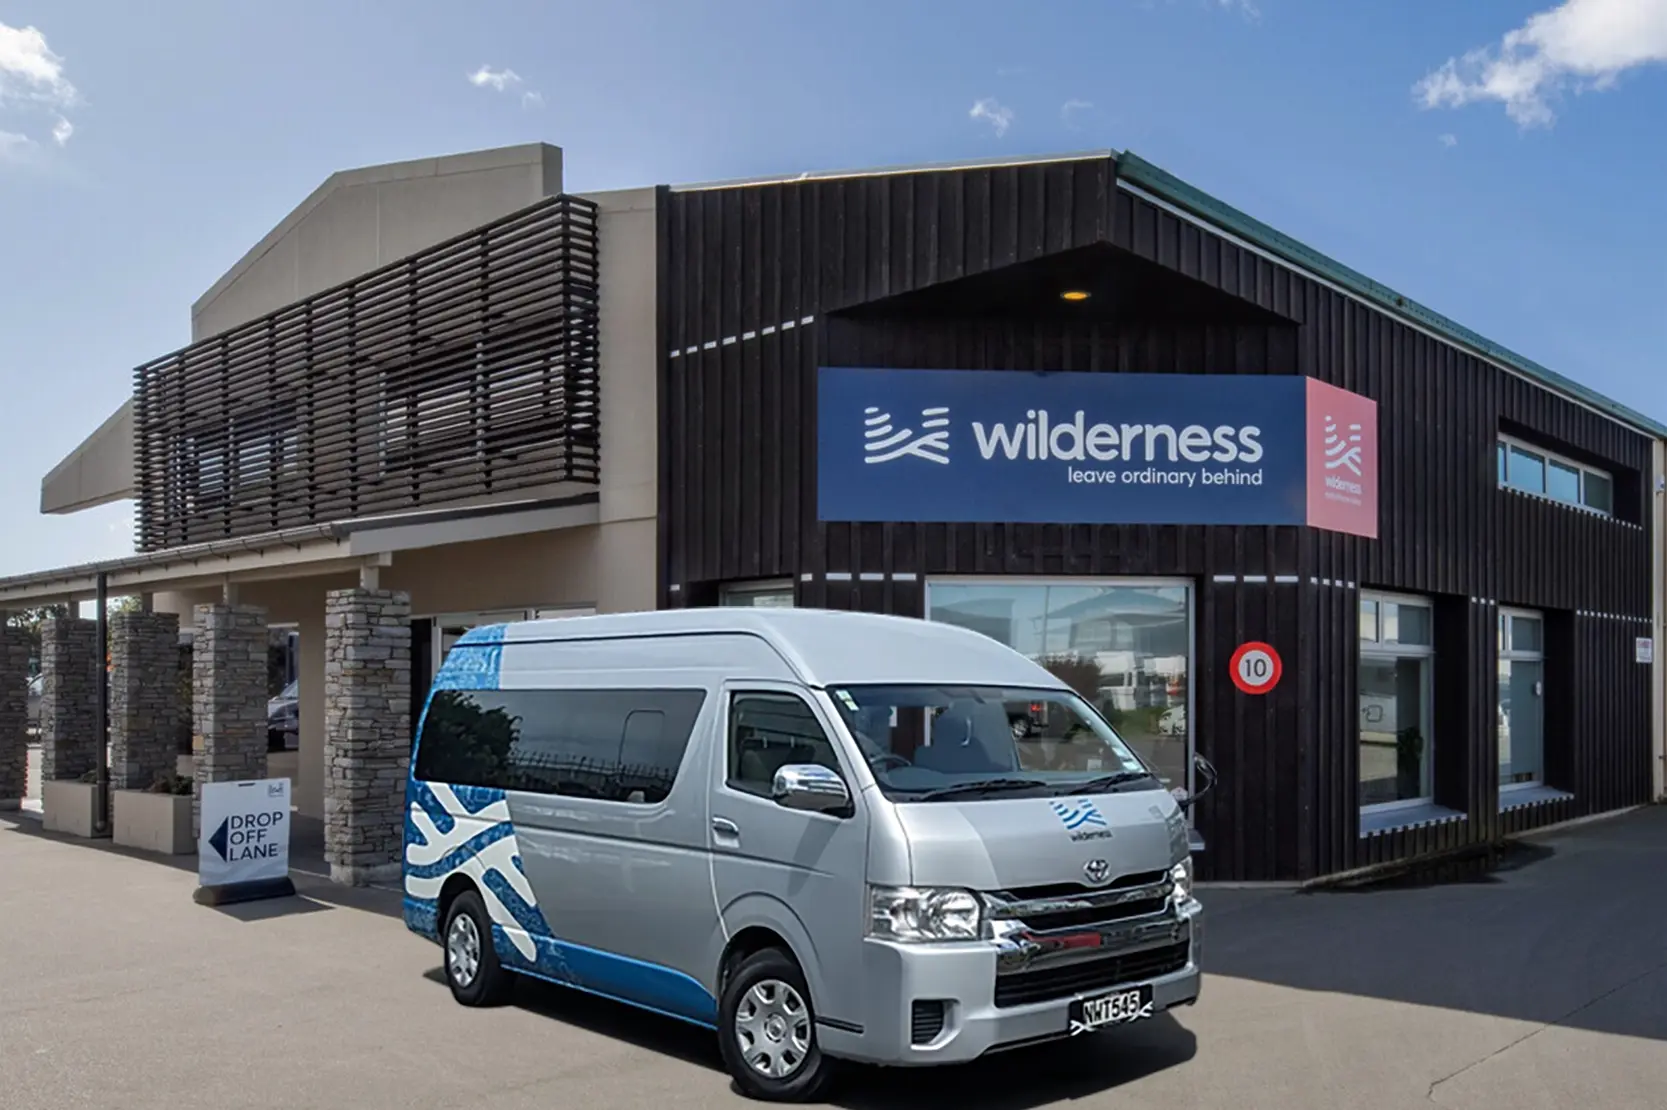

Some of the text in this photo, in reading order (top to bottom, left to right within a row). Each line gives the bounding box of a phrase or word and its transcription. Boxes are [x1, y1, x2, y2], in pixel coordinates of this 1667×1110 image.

[972, 409, 1263, 463] wilderness
[1068, 466, 1263, 488] leave ordinary behind
[1245, 658, 1267, 677] 10
[231, 811, 283, 829] DROP
[230, 828, 268, 845] OFF
[230, 843, 278, 861] LANE
[1083, 990, 1140, 1025] NHT545
